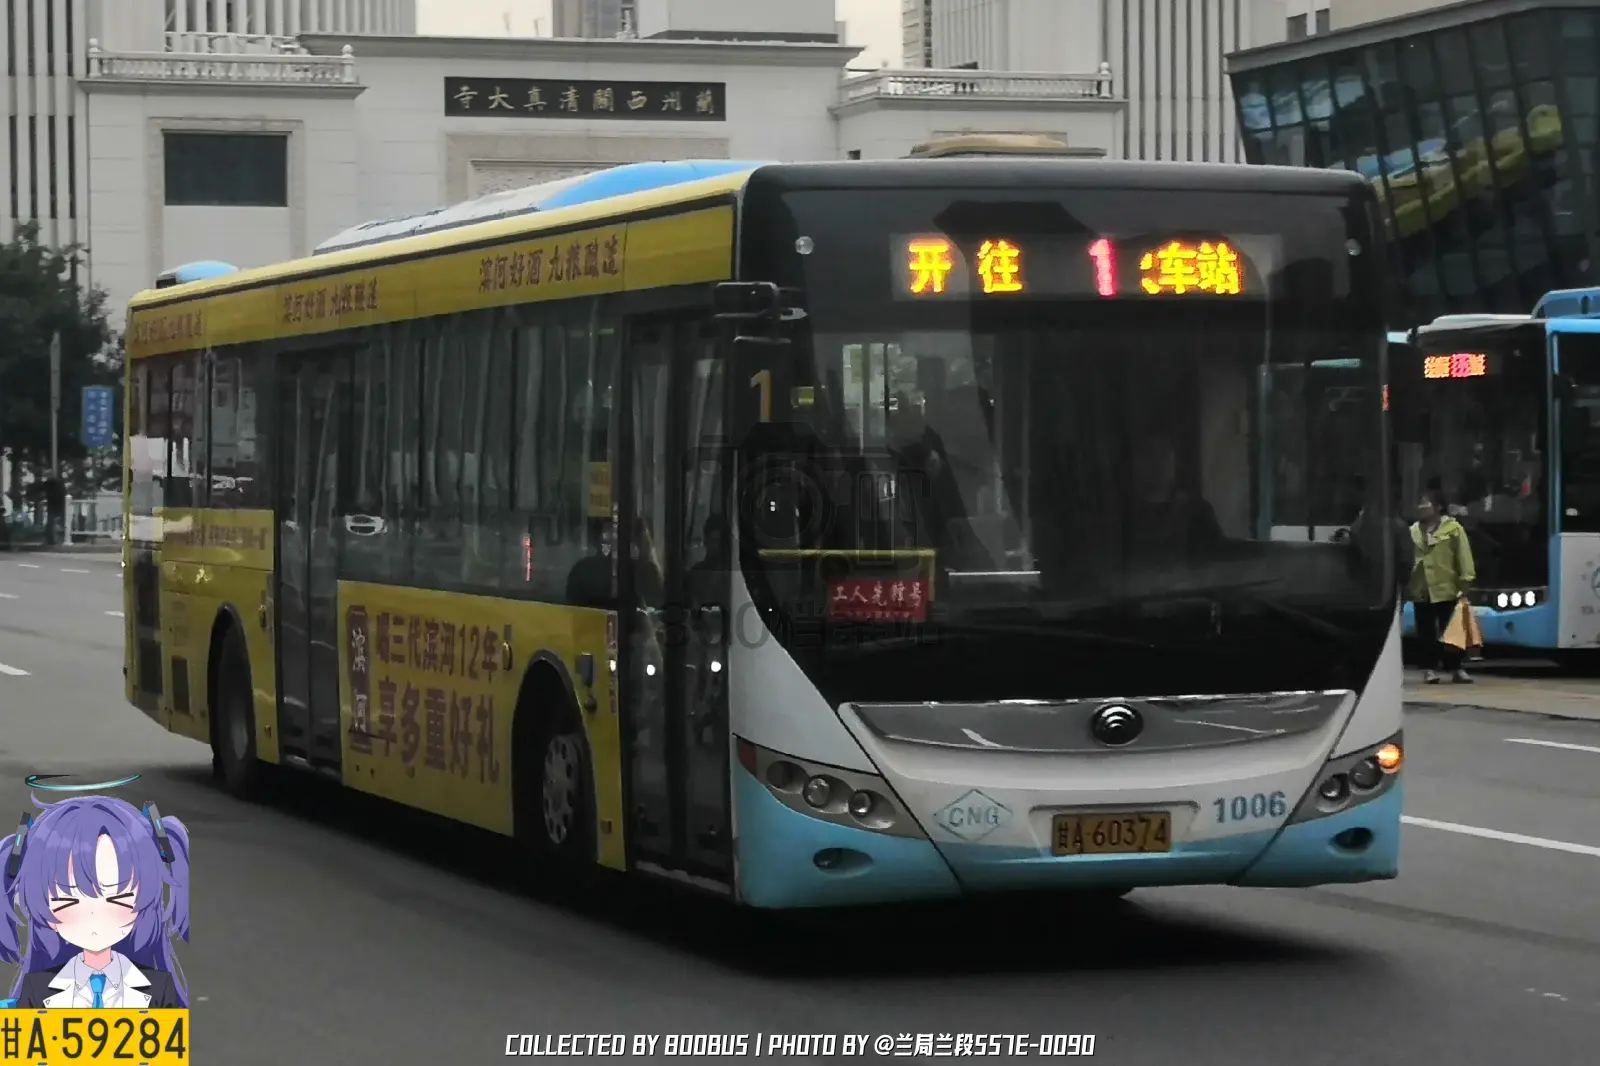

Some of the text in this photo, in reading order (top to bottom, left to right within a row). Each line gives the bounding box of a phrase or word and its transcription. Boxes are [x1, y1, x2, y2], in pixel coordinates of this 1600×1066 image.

[1087, 238, 1117, 296] 1
[750, 369, 771, 422] 1
[948, 805, 999, 829] CNG
[1212, 790, 1287, 824] 1006
